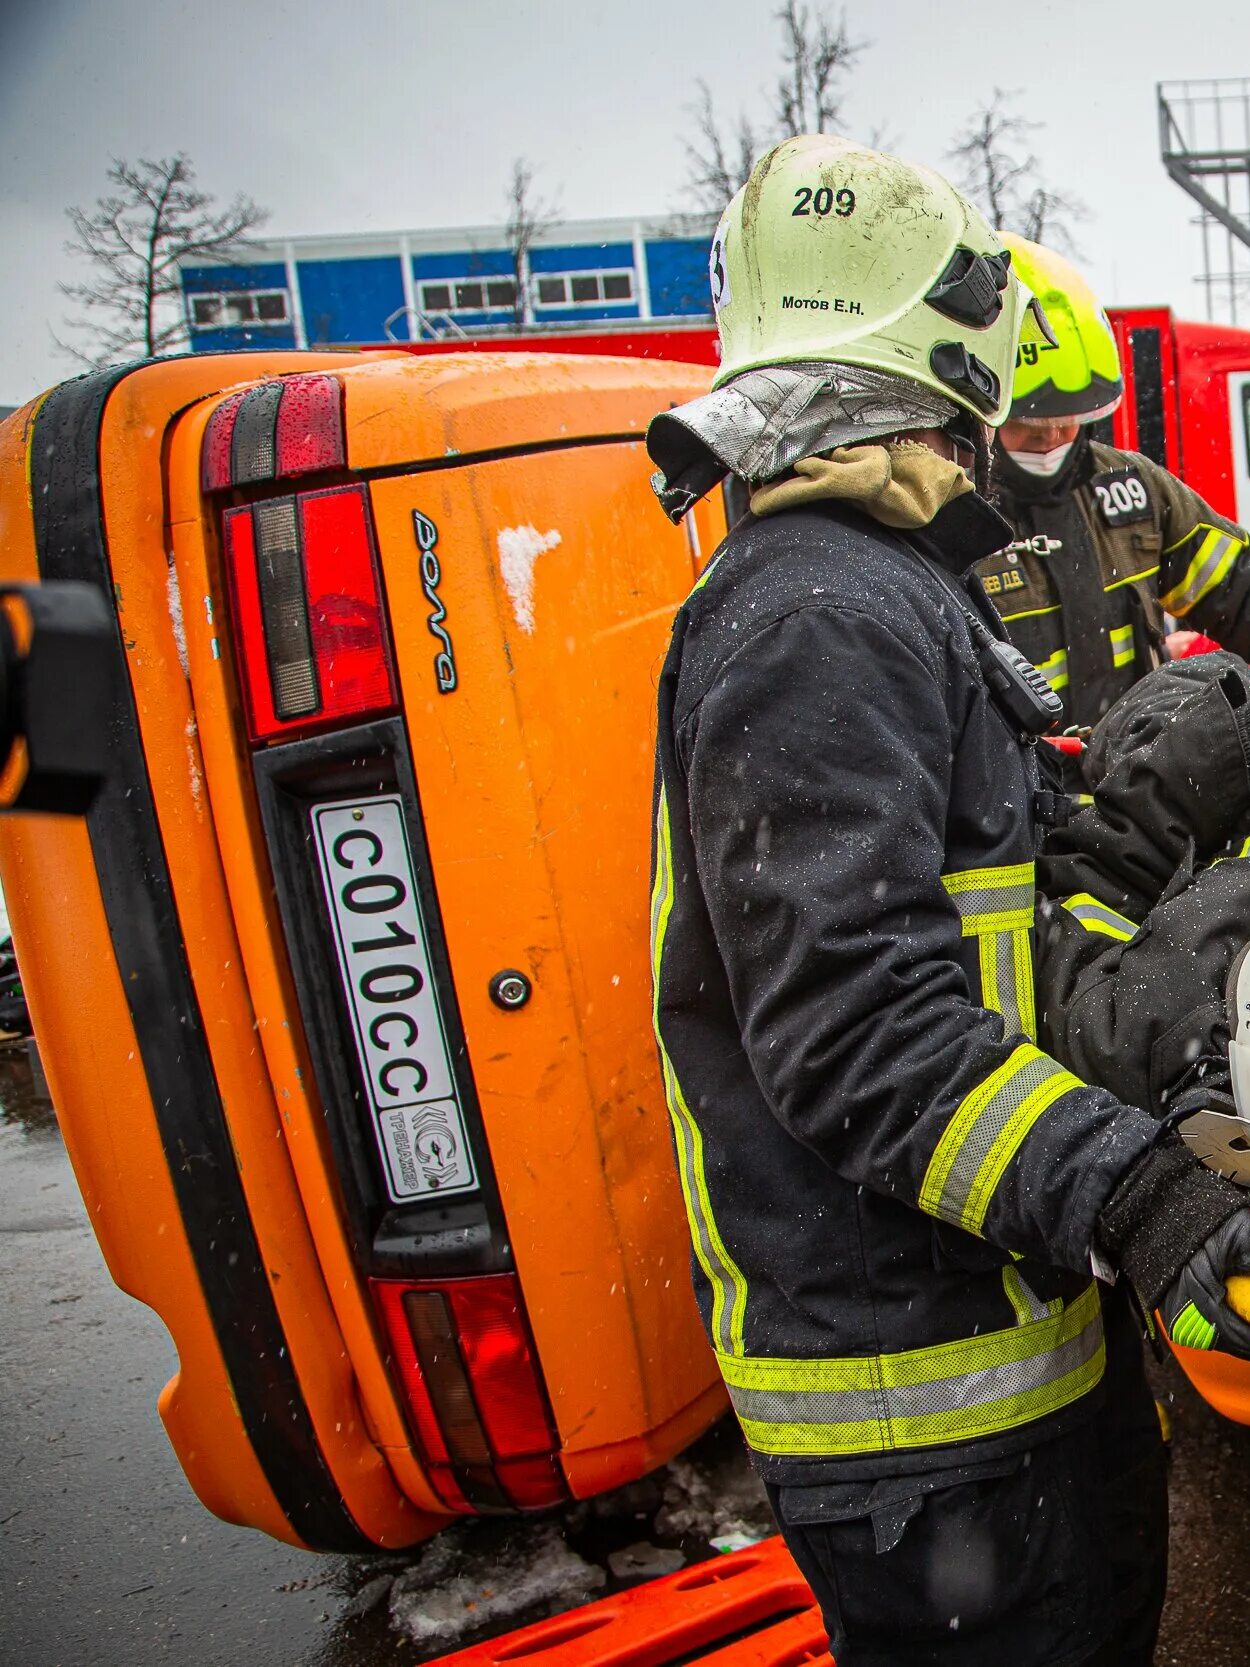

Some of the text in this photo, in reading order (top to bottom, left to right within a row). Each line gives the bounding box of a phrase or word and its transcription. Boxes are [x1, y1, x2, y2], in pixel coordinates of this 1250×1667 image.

[792, 187, 856, 217] 209
[782, 296, 865, 316] Мотов Е.Н.
[1095, 478, 1147, 517] 209
[390, 1111, 420, 1190] ТРЕНАЖЕР
